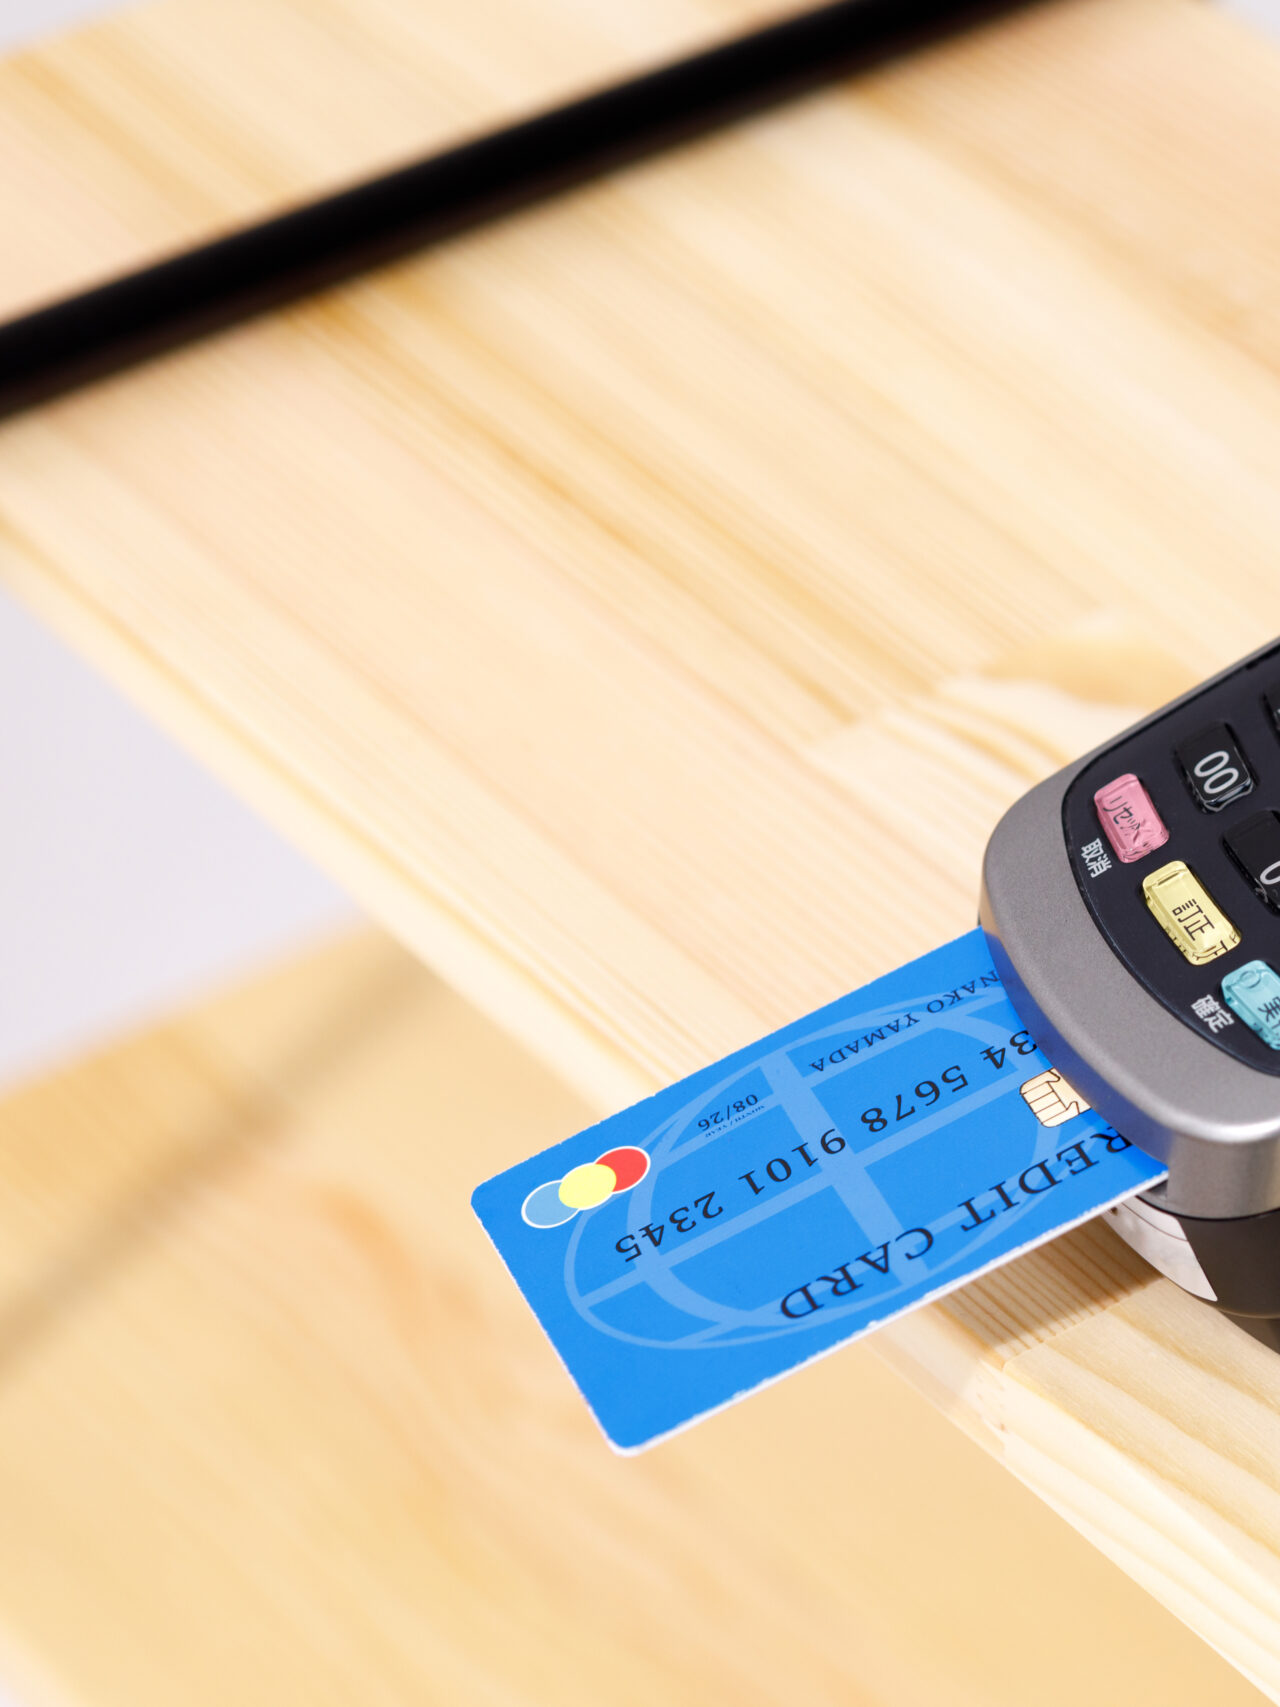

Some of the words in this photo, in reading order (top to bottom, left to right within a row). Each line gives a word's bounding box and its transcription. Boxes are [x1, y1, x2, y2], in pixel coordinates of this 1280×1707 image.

[1193, 750, 1240, 795] 00
[1081, 837, 1113, 879] 取消
[1172, 898, 1215, 942] 訂正
[926, 969, 1001, 1014] NAKO
[1190, 993, 1236, 1034] 確定
[808, 1012, 921, 1073] YAMADA
[979, 1029, 1038, 1070] 34
[697, 1093, 759, 1132] 08/26
[859, 1064, 970, 1134] 5678
[737, 1127, 847, 1197] 9101
[959, 1126, 1134, 1233] REDIT
[614, 1189, 724, 1263] 2345
[778, 1226, 935, 1321] CARD
